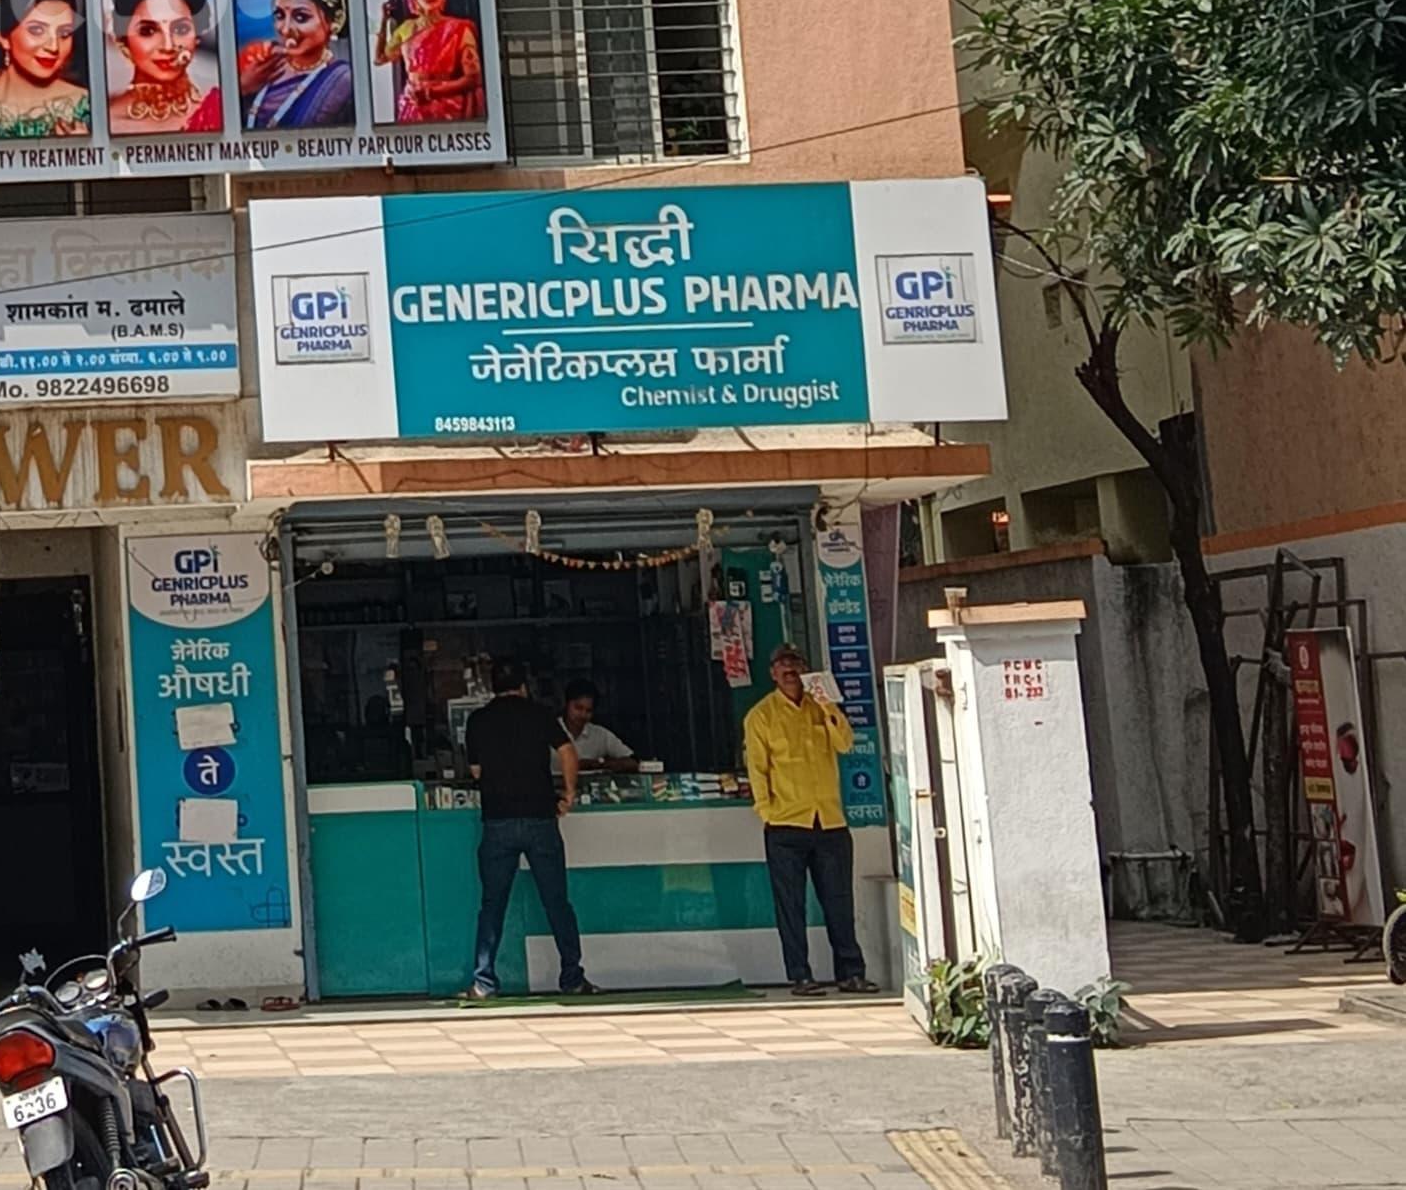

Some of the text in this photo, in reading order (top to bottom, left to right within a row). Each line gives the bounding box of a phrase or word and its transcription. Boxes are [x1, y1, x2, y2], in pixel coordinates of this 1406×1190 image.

[21, 145, 105, 169] TREATMENT
[126, 142, 216, 165] PERMANENT
[218, 140, 280, 162] MAKEUP
[298, 138, 355, 159] BEAUTY
[358, 134, 425, 156] PARLOUR
[427, 131, 492, 153] CLASSES
[546, 204, 694, 268] सिद्धी
[5, 294, 89, 323] शामकांत
[97, 300, 121, 317] म.
[393, 271, 860, 324] GENERICPLUS PHARMA
[885, 304, 975, 320] GENRICPLUS
[111, 322, 186, 342] (B.A.M.S)
[280, 323, 370, 340] GENRICPLUS
[903, 319, 960, 333] PHARMA
[296, 338, 353, 352] PHARMA
[470, 334, 790, 384] जेनेरिकप्लस फार्मा
[36, 374, 170, 397] 9822496698
[621, 379, 841, 408] Chemist & Druggist
[434, 414, 516, 432] 8459843113
[150, 575, 250, 592] GENRICPLUS
[170, 592, 232, 608] PHARMA
[170, 639, 231, 663] जेनेरिक
[157, 661, 253, 699] औषधी
[197, 756, 222, 786] ते
[12, 1092, 58, 1124] 6236
